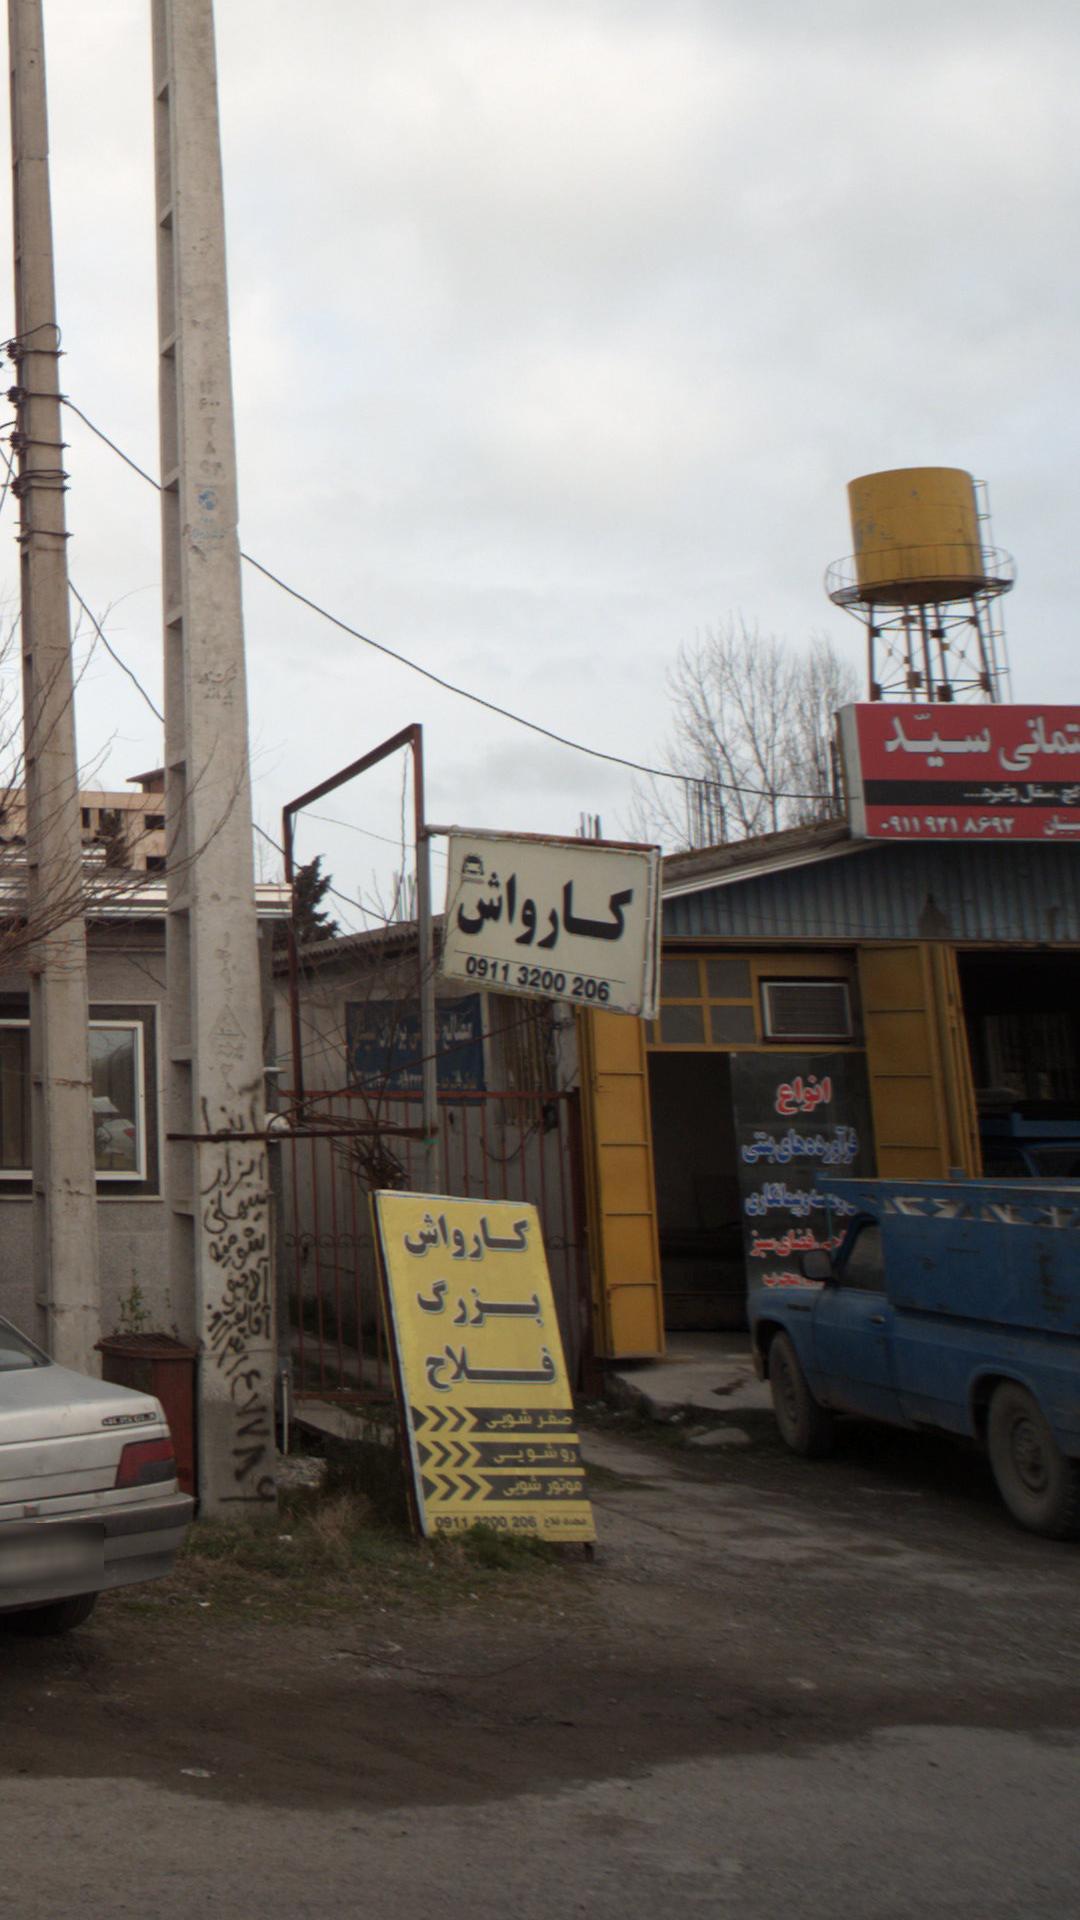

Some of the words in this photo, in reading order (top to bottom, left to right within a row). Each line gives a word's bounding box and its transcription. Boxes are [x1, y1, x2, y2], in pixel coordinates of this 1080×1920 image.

[457, 871, 634, 949] کارواش
[466, 956, 510, 981] 0911
[517, 966, 566, 992] 3200
[572, 976, 610, 1001] 206
[775, 1074, 832, 1115] انواع
[404, 1213, 528, 1260] کارواش
[417, 1279, 544, 1327] بزرگ
[425, 1345, 556, 1392] فلاح
[435, 1516, 468, 1529] 0911
[511, 1516, 538, 1529] 206
